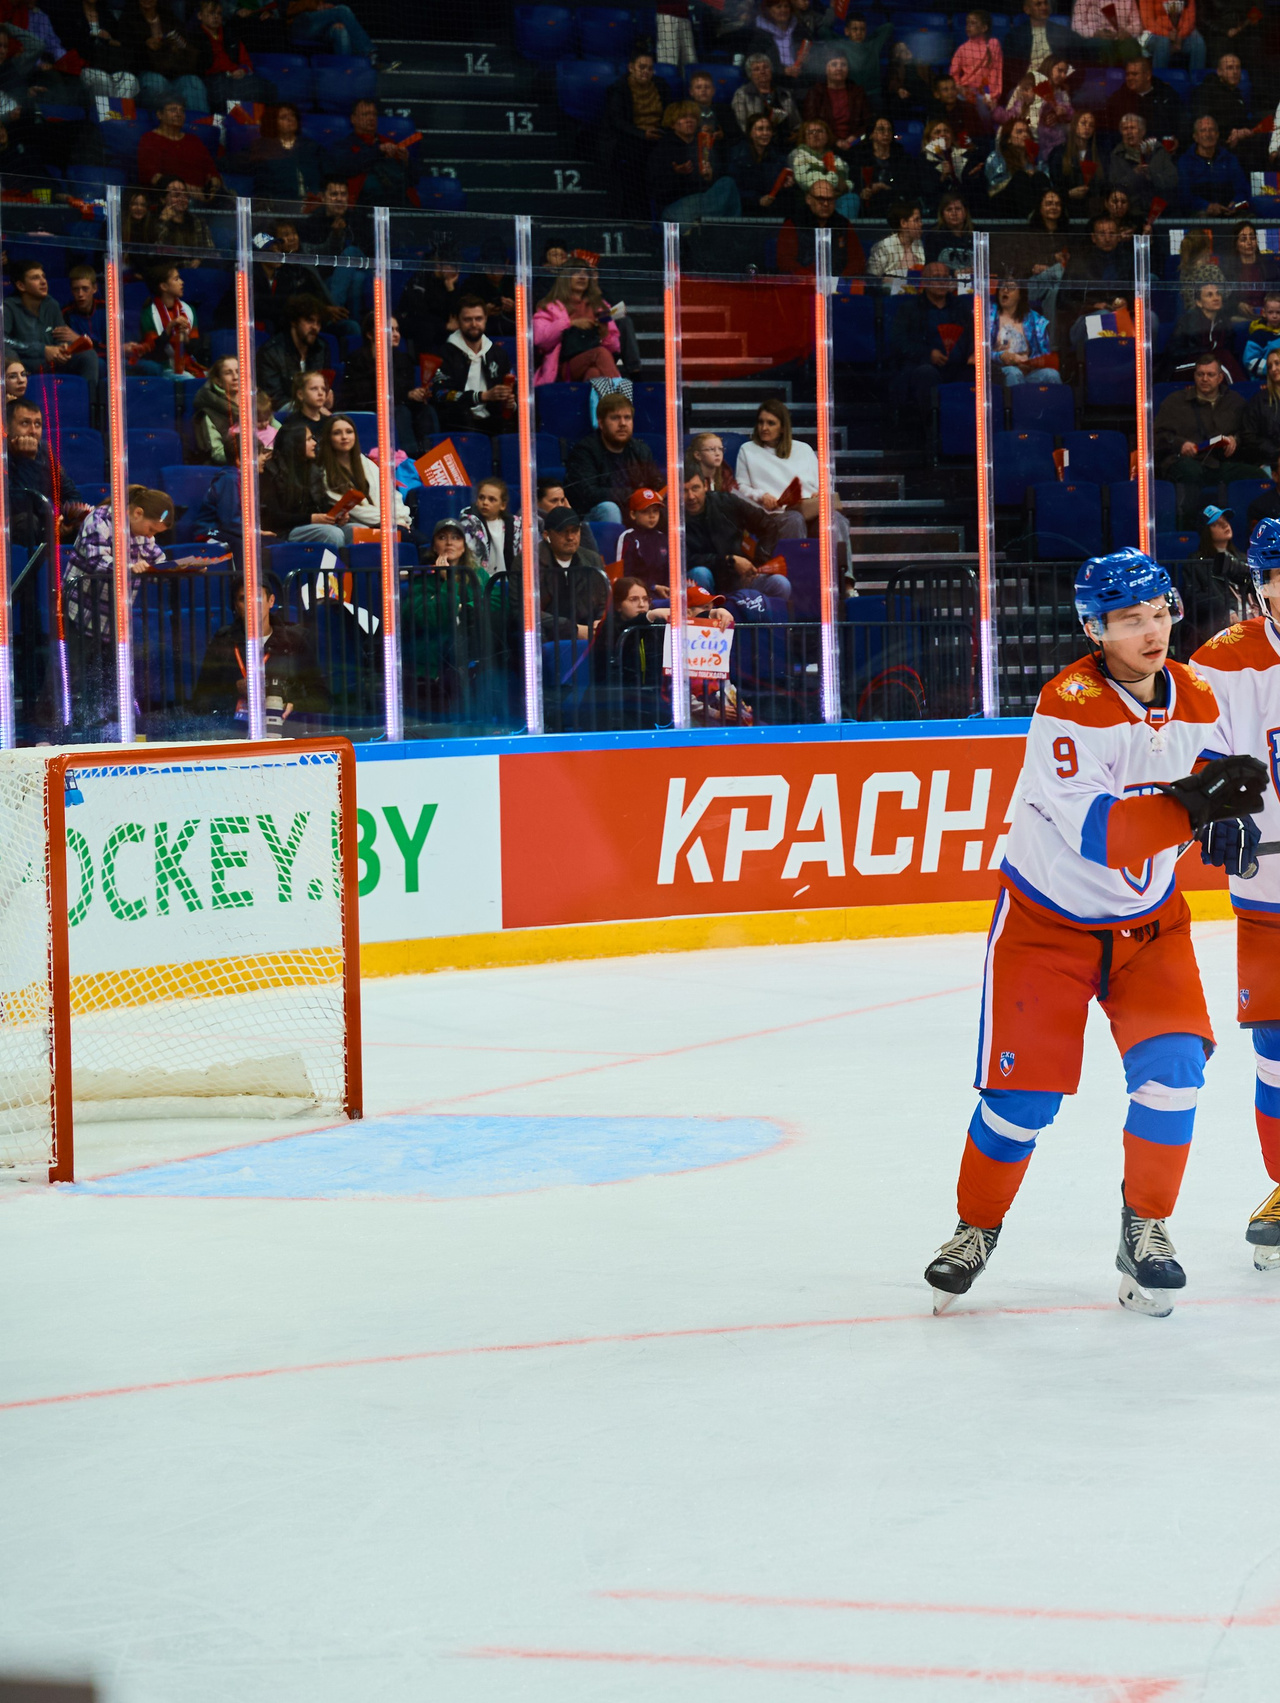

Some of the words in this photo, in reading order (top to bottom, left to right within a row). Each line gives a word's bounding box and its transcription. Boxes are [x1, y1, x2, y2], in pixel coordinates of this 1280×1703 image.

[464, 53, 490, 75] 14
[505, 111, 534, 133] 13
[553, 169, 582, 191] 12
[601, 232, 626, 255] 11
[1129, 574, 1154, 587] CCM
[1052, 736, 1079, 778] 9
[22, 803, 438, 928] OCKEY.BY
